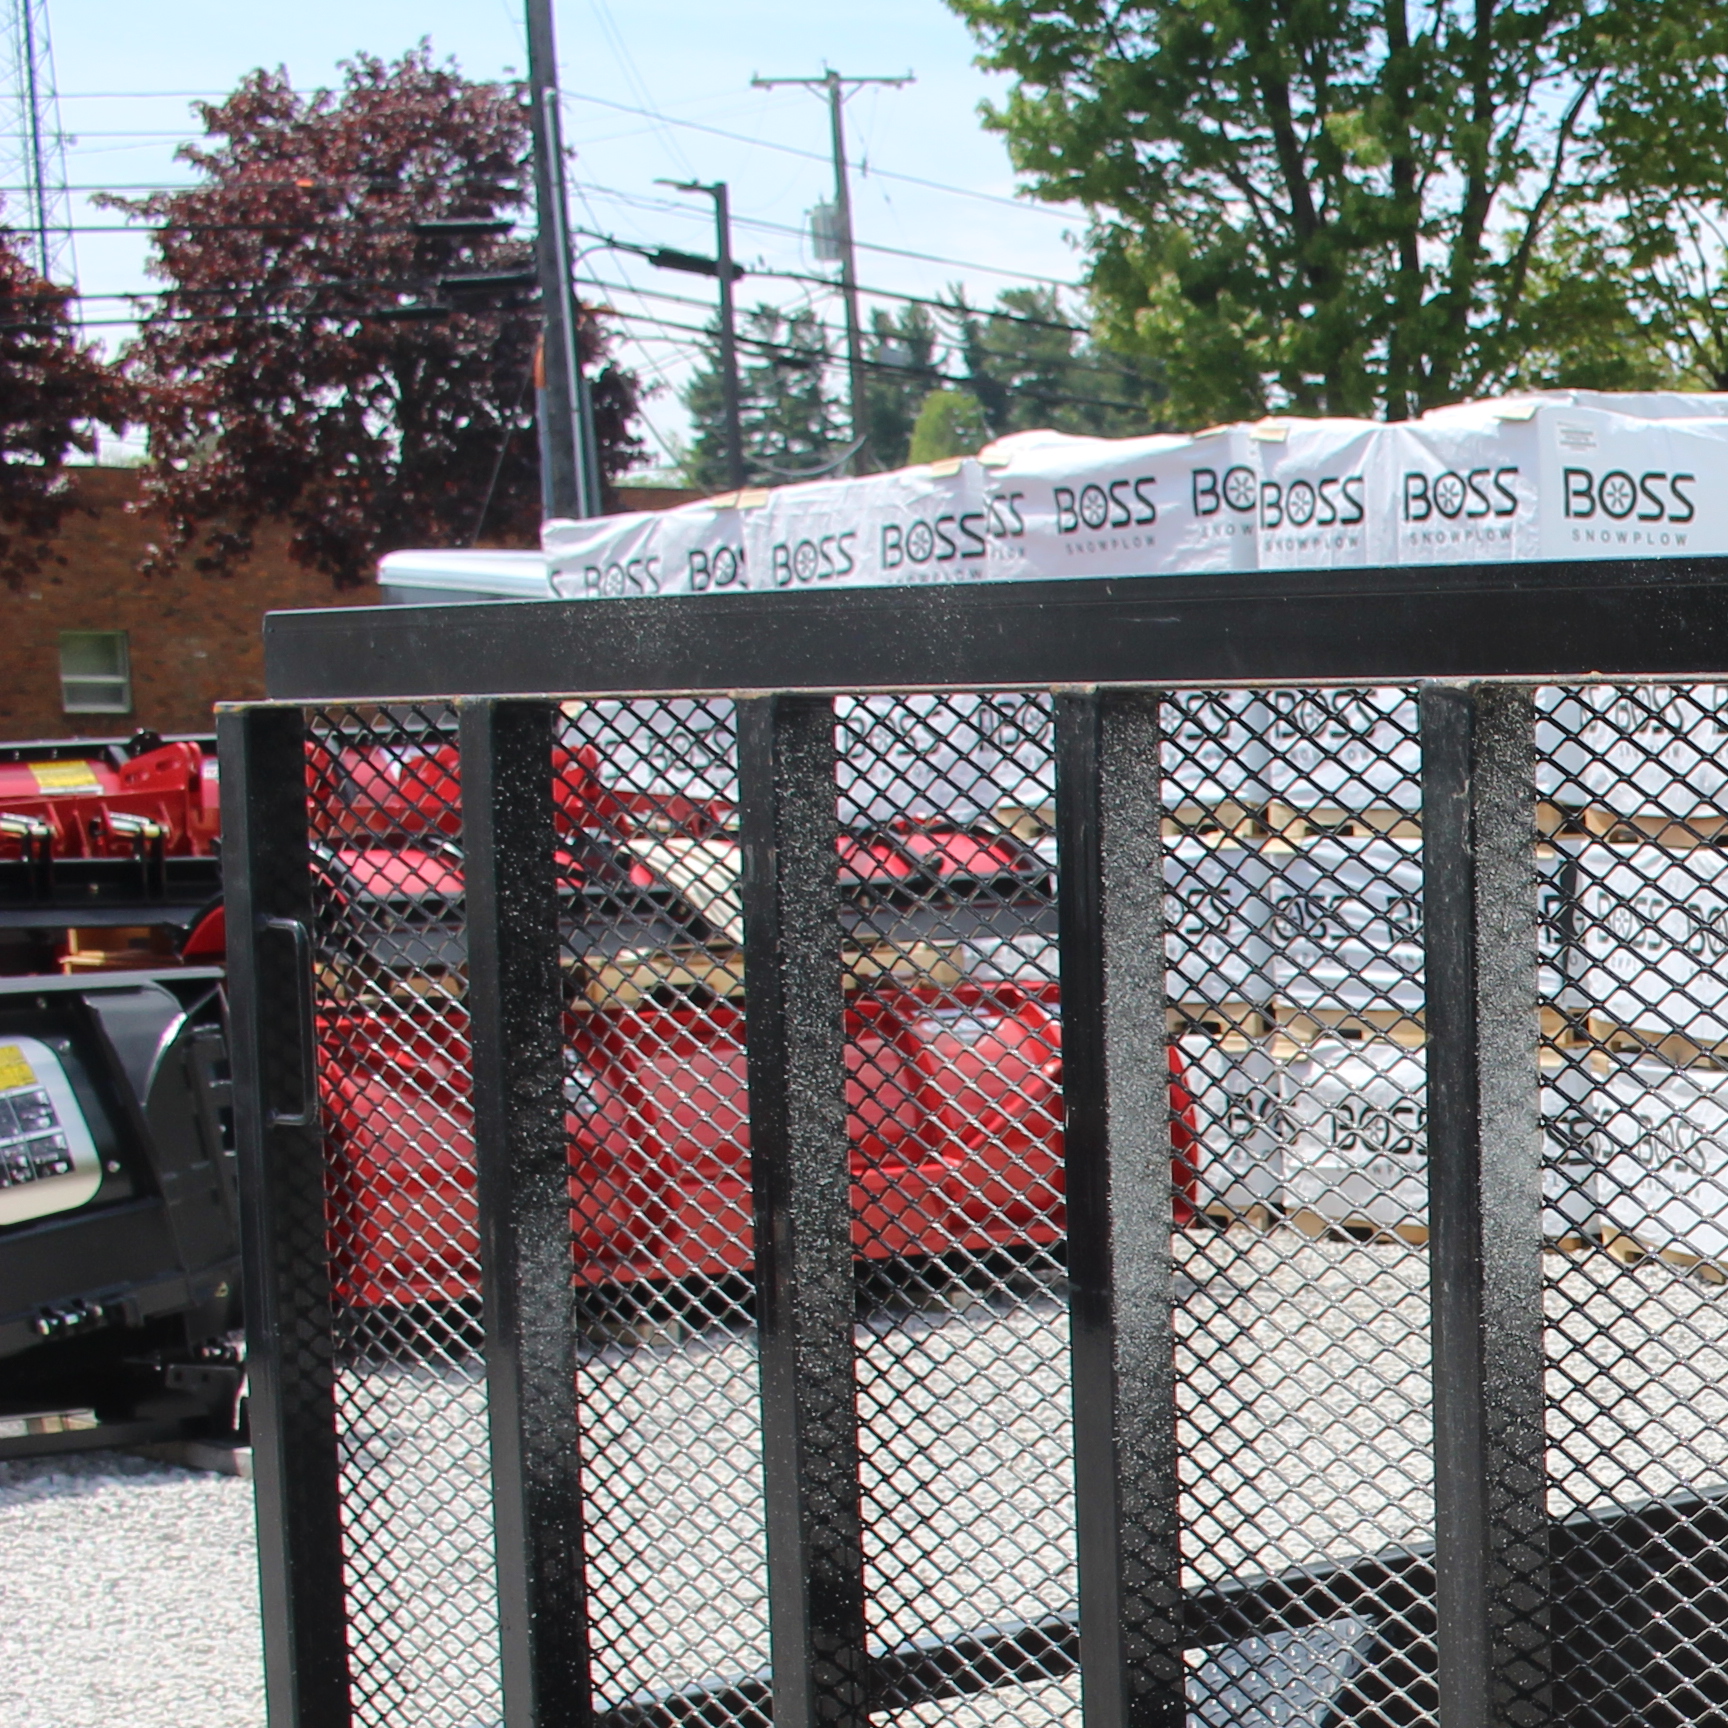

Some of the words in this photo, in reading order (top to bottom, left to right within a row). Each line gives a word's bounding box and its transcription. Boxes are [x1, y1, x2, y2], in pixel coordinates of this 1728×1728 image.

[1054, 476, 1156, 534] BOSS
[1259, 476, 1364, 529] BOSS
[1404, 466, 1518, 521] BOSS
[1562, 465, 1695, 523] BOSS
[773, 532, 856, 586] BOSS
[881, 513, 985, 569] BOSS
[1065, 534, 1155, 554] SNOWPLOW
[1264, 535, 1359, 551] SNOWPLOW
[1410, 528, 1514, 545] SNOWPLOW
[1571, 528, 1688, 545] SNOWPLOW
[689, 545, 748, 592] BO
